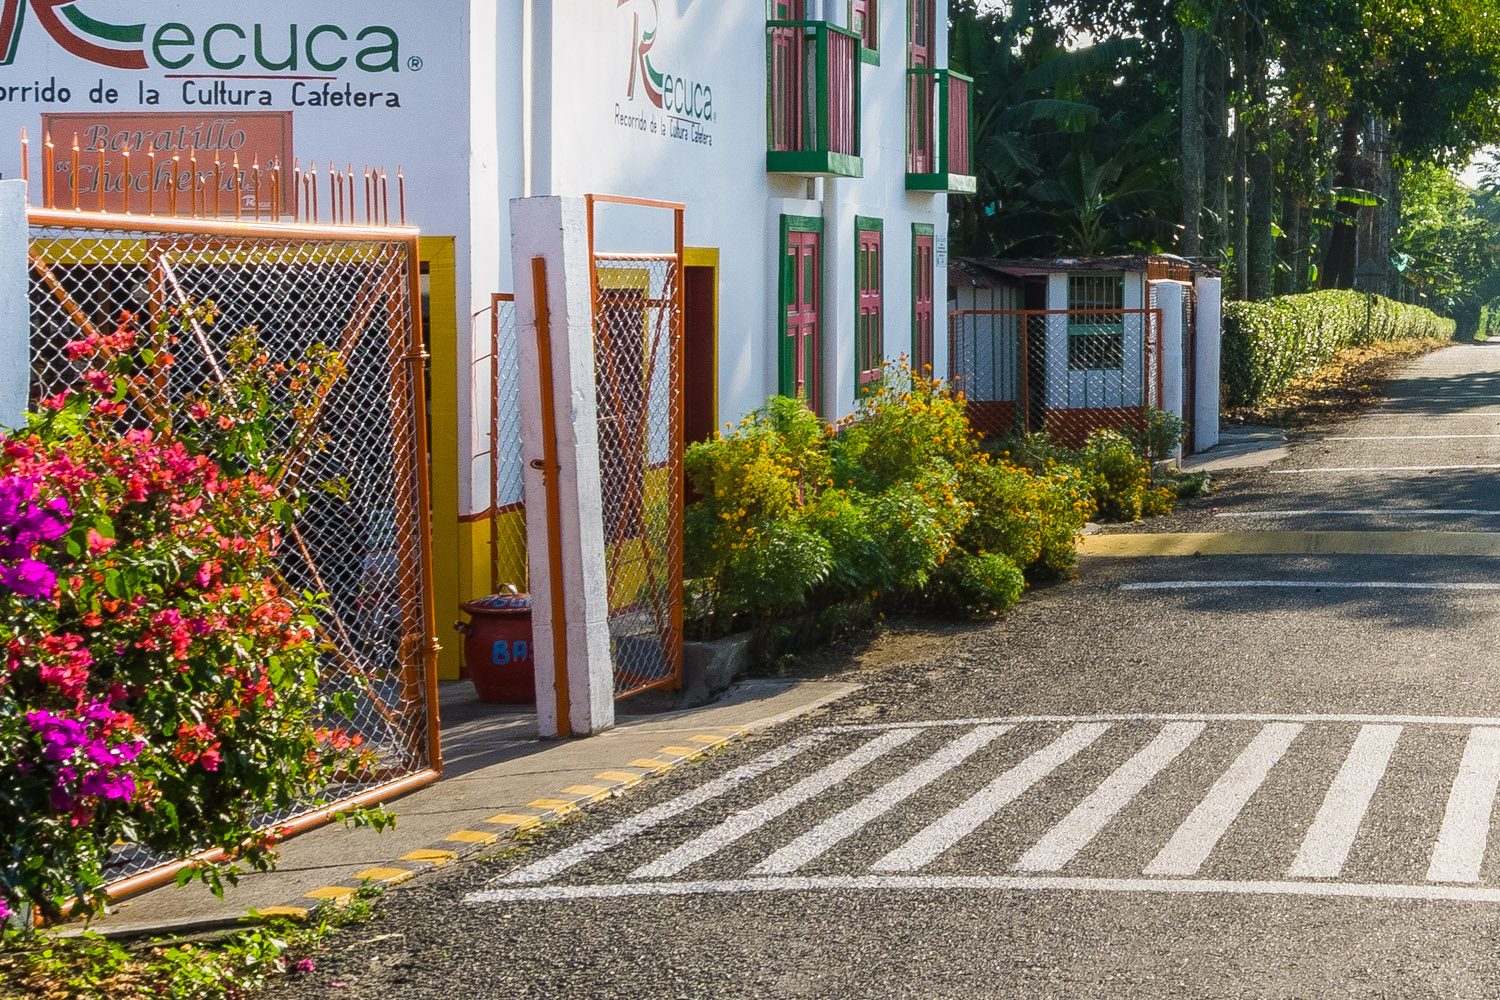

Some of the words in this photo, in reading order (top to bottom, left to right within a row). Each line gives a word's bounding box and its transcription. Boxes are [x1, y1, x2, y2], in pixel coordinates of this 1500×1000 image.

[89, 79, 119, 103] de
[139, 80, 160, 105] la
[182, 80, 272, 106] Cultura
[292, 82, 401, 107] Cafetera
[614, 102, 647, 131] Recorrido
[650, 113, 657, 134] de
[661, 116, 666, 136] la
[83, 119, 246, 152] Baratillo
[492, 640, 534, 665] BA
